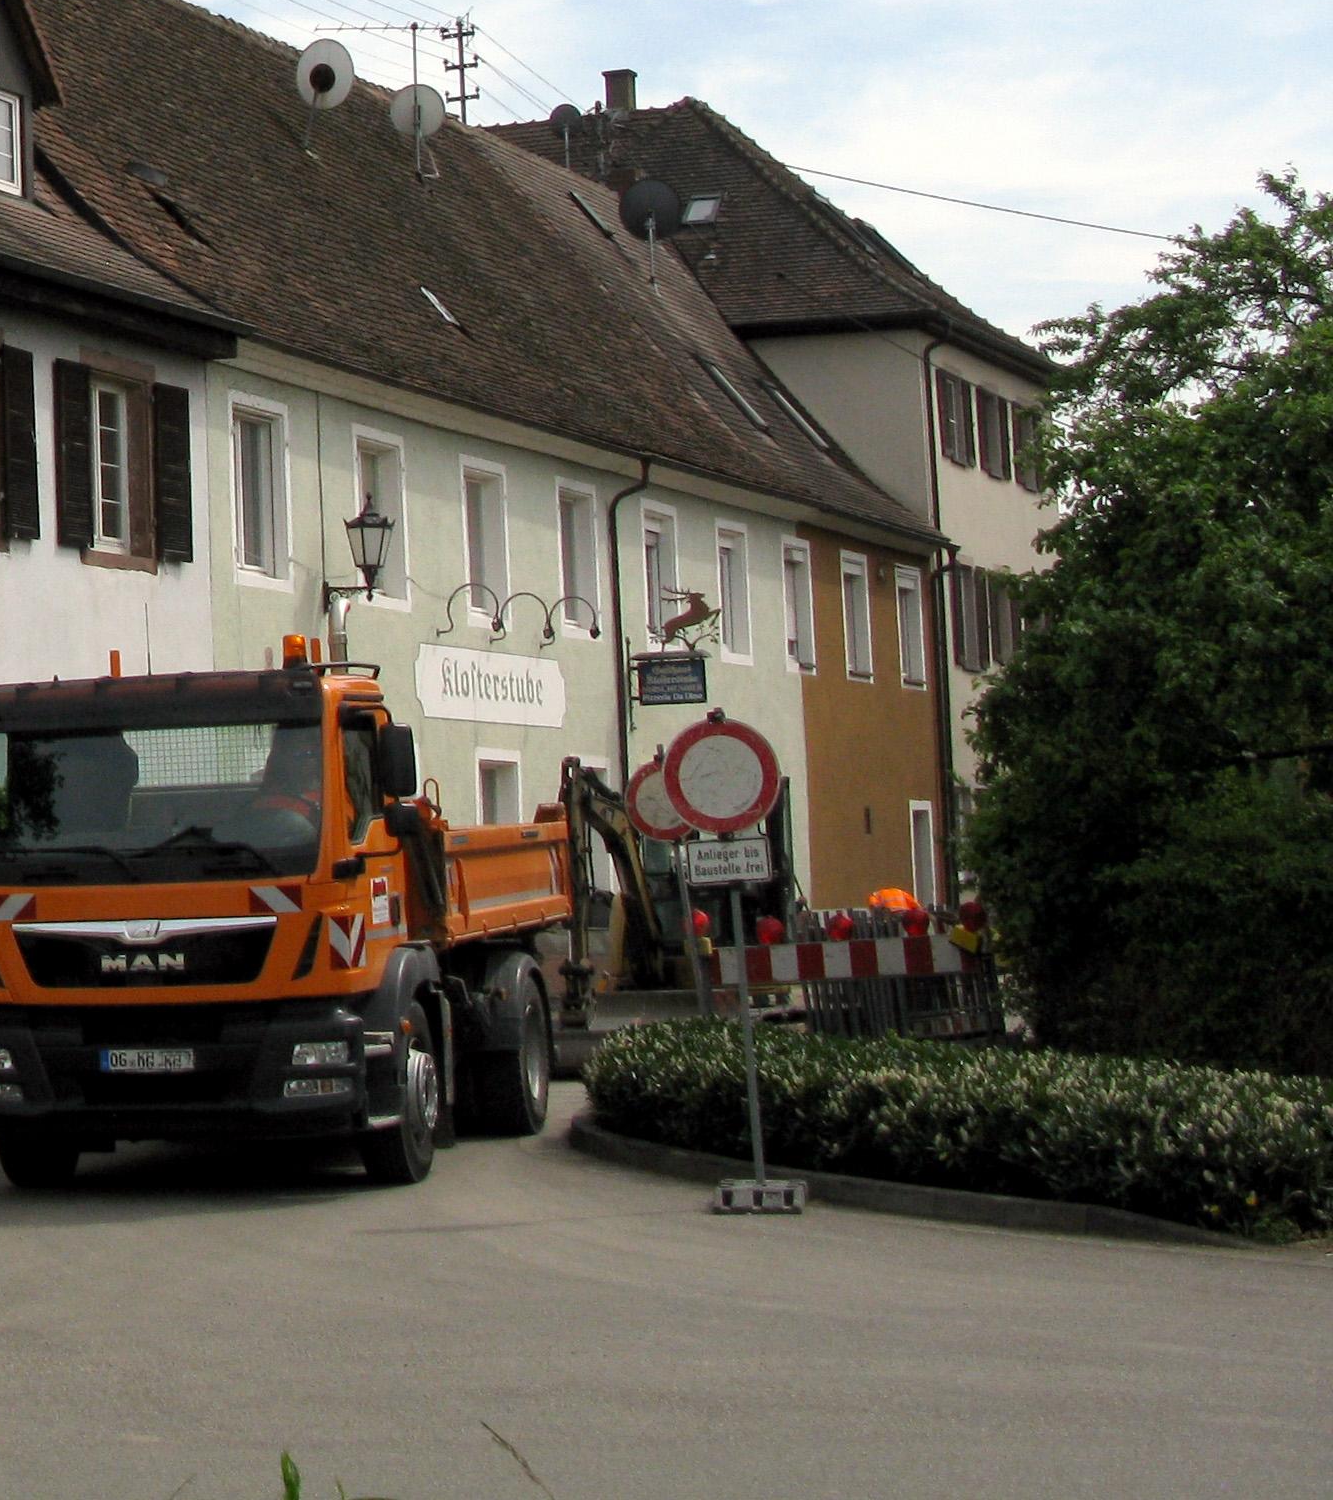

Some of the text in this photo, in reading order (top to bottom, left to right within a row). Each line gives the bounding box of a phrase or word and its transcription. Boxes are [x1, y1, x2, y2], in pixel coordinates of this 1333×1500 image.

[696, 845, 760, 862] Anlieger bis
[694, 860, 764, 876] Baustelle frei
[100, 953, 186, 972] MAN
